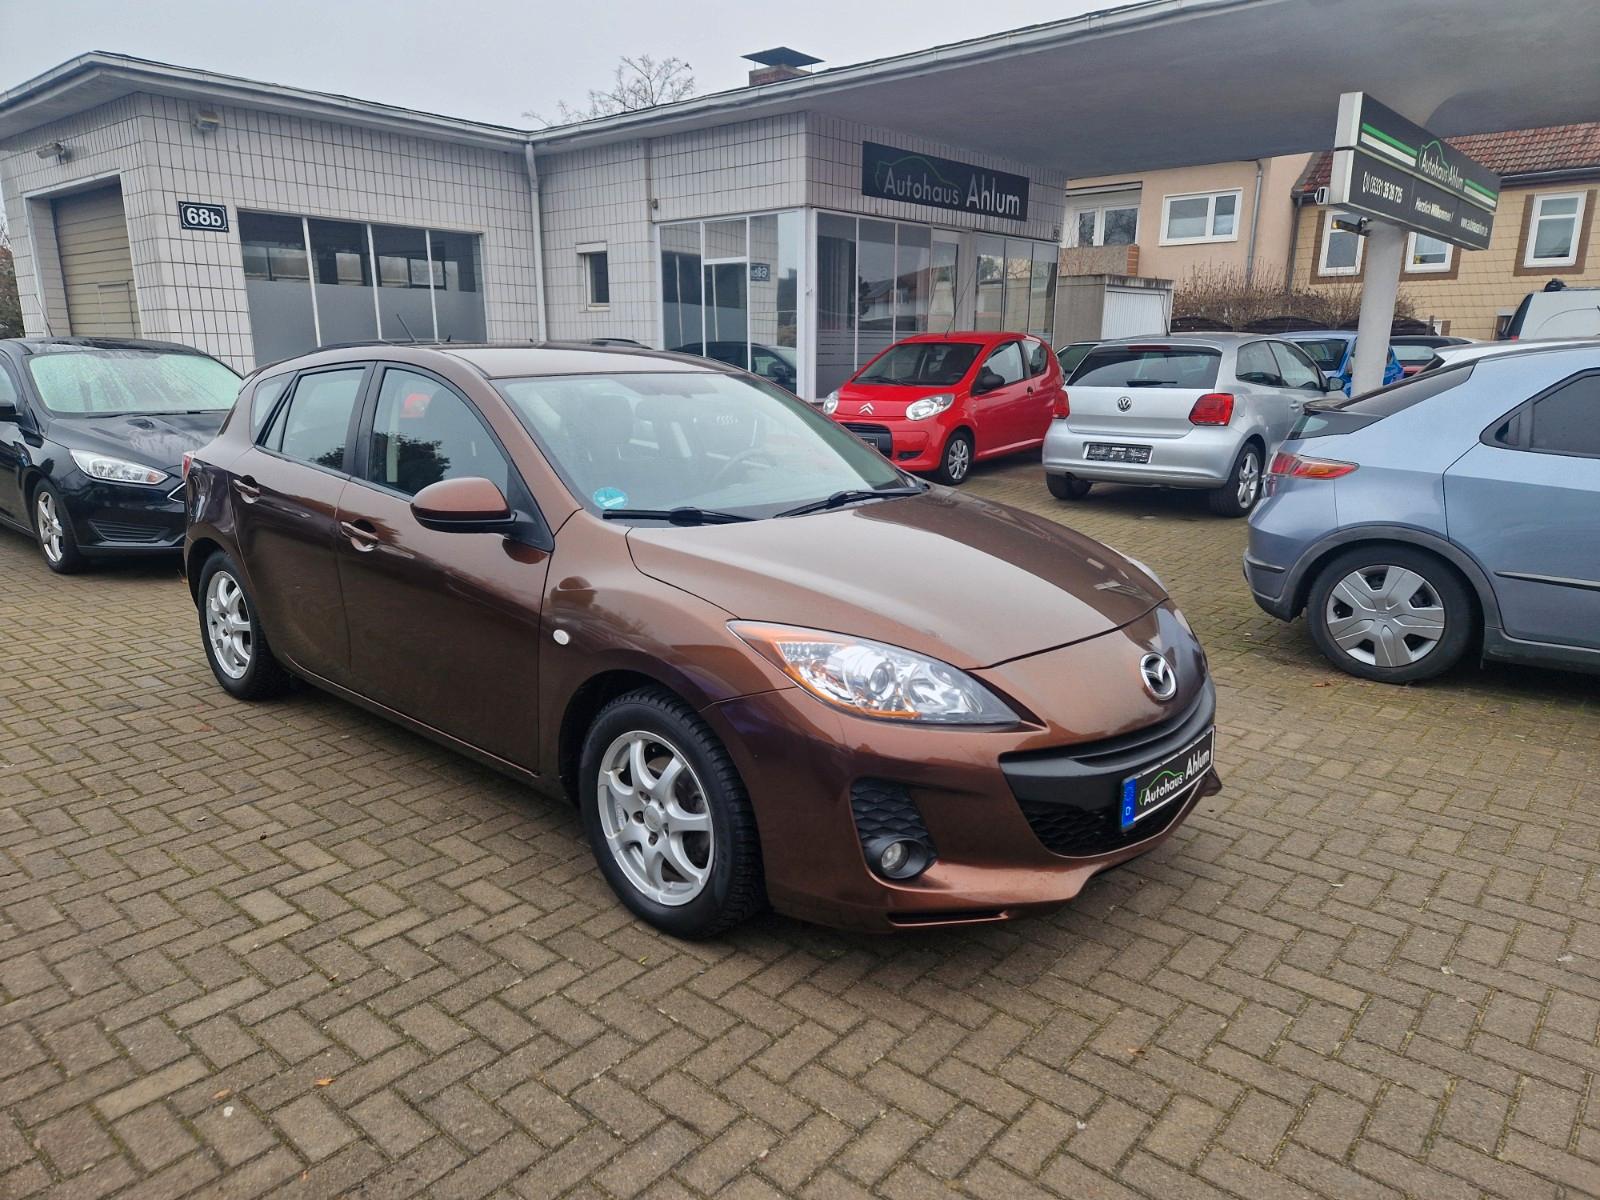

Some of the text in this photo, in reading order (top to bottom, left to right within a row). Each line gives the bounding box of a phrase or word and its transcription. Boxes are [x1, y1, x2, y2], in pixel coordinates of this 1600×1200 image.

[1421, 150, 1449, 184] Autohaus
[883, 167, 1020, 216] Autohaus Ahlum
[186, 207, 222, 227] 68b
[1143, 749, 1210, 806] Autohaus Ahlum
